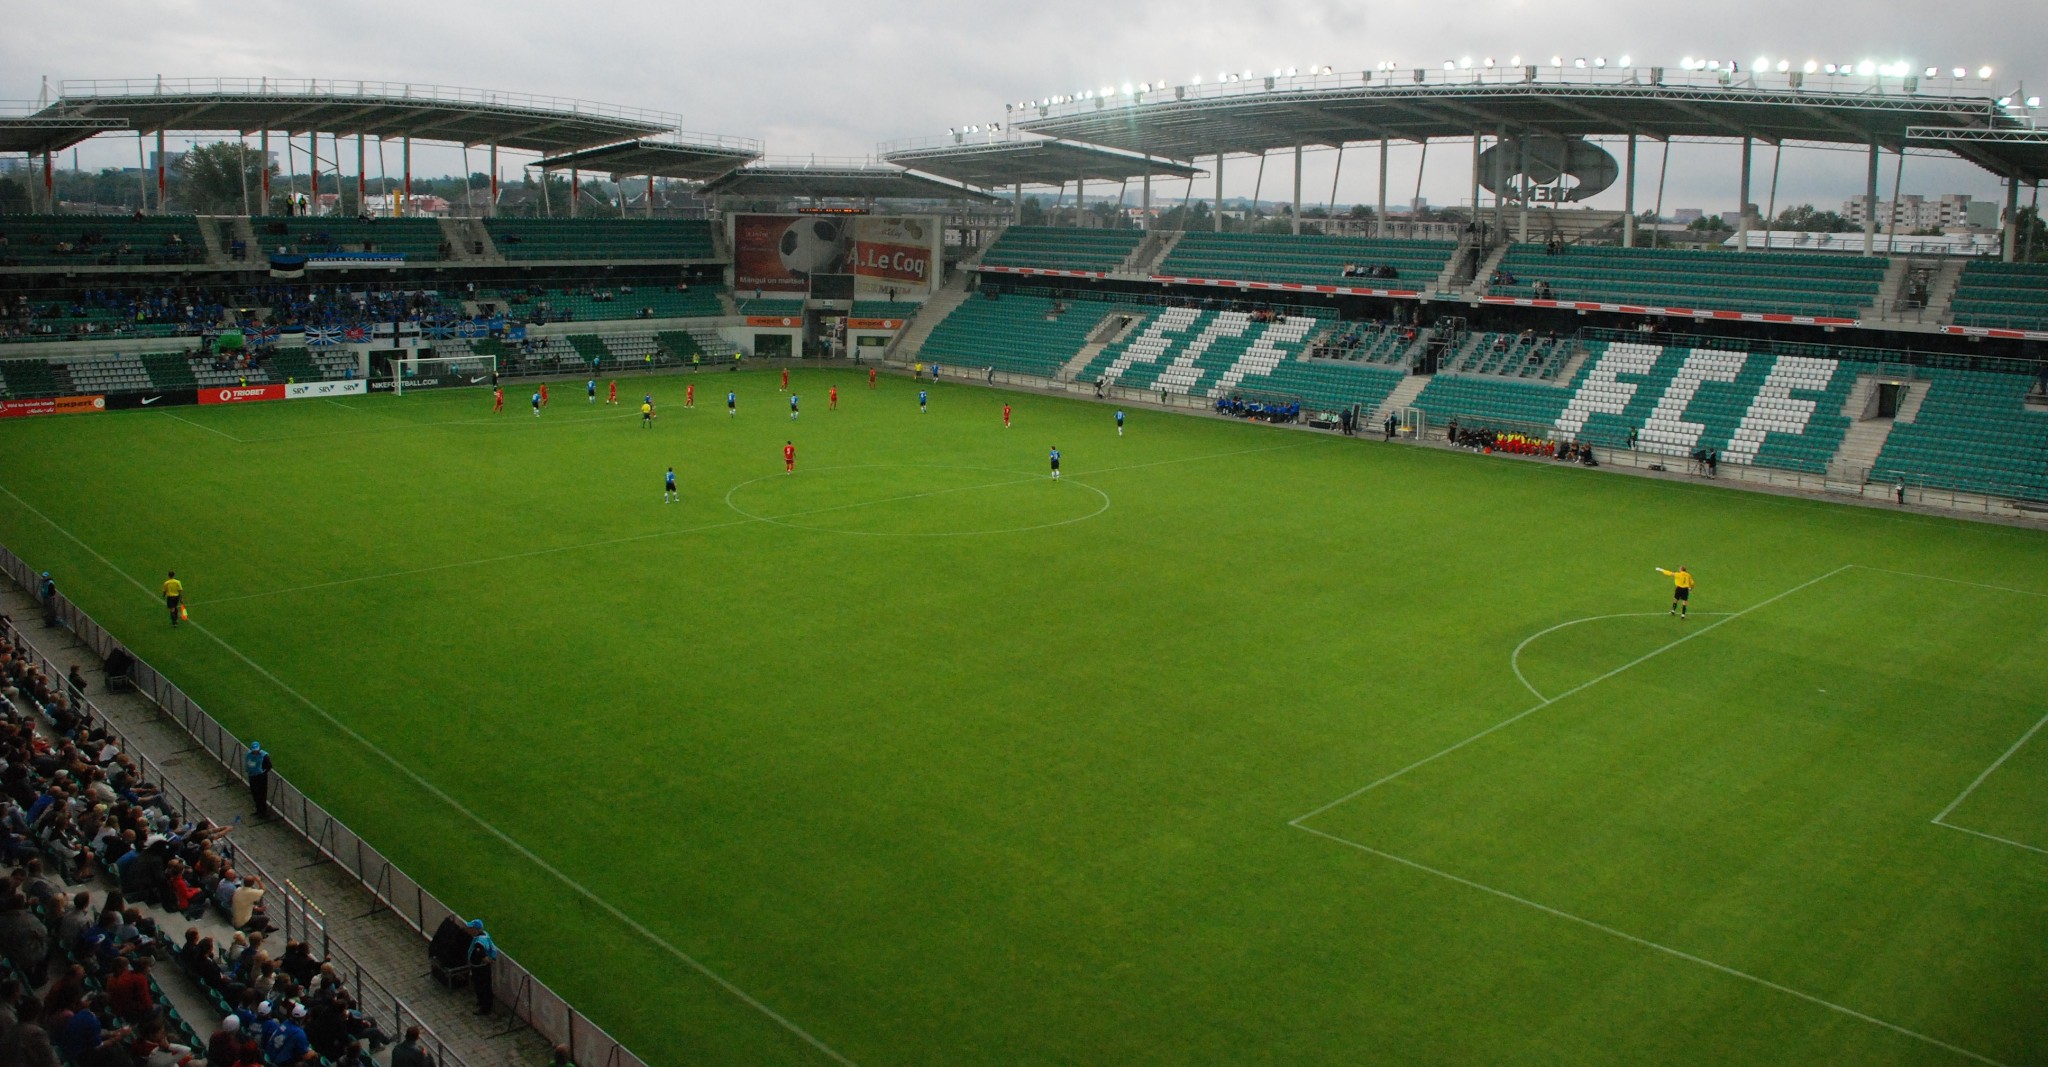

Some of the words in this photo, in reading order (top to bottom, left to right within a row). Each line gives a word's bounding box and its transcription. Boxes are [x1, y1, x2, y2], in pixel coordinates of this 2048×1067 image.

[892, 252, 925, 278] Coq
[232, 388, 266, 397] TRIOBET
[293, 387, 308, 395] SRV
[318, 385, 333, 394] SRV
[56, 400, 92, 409] expert
